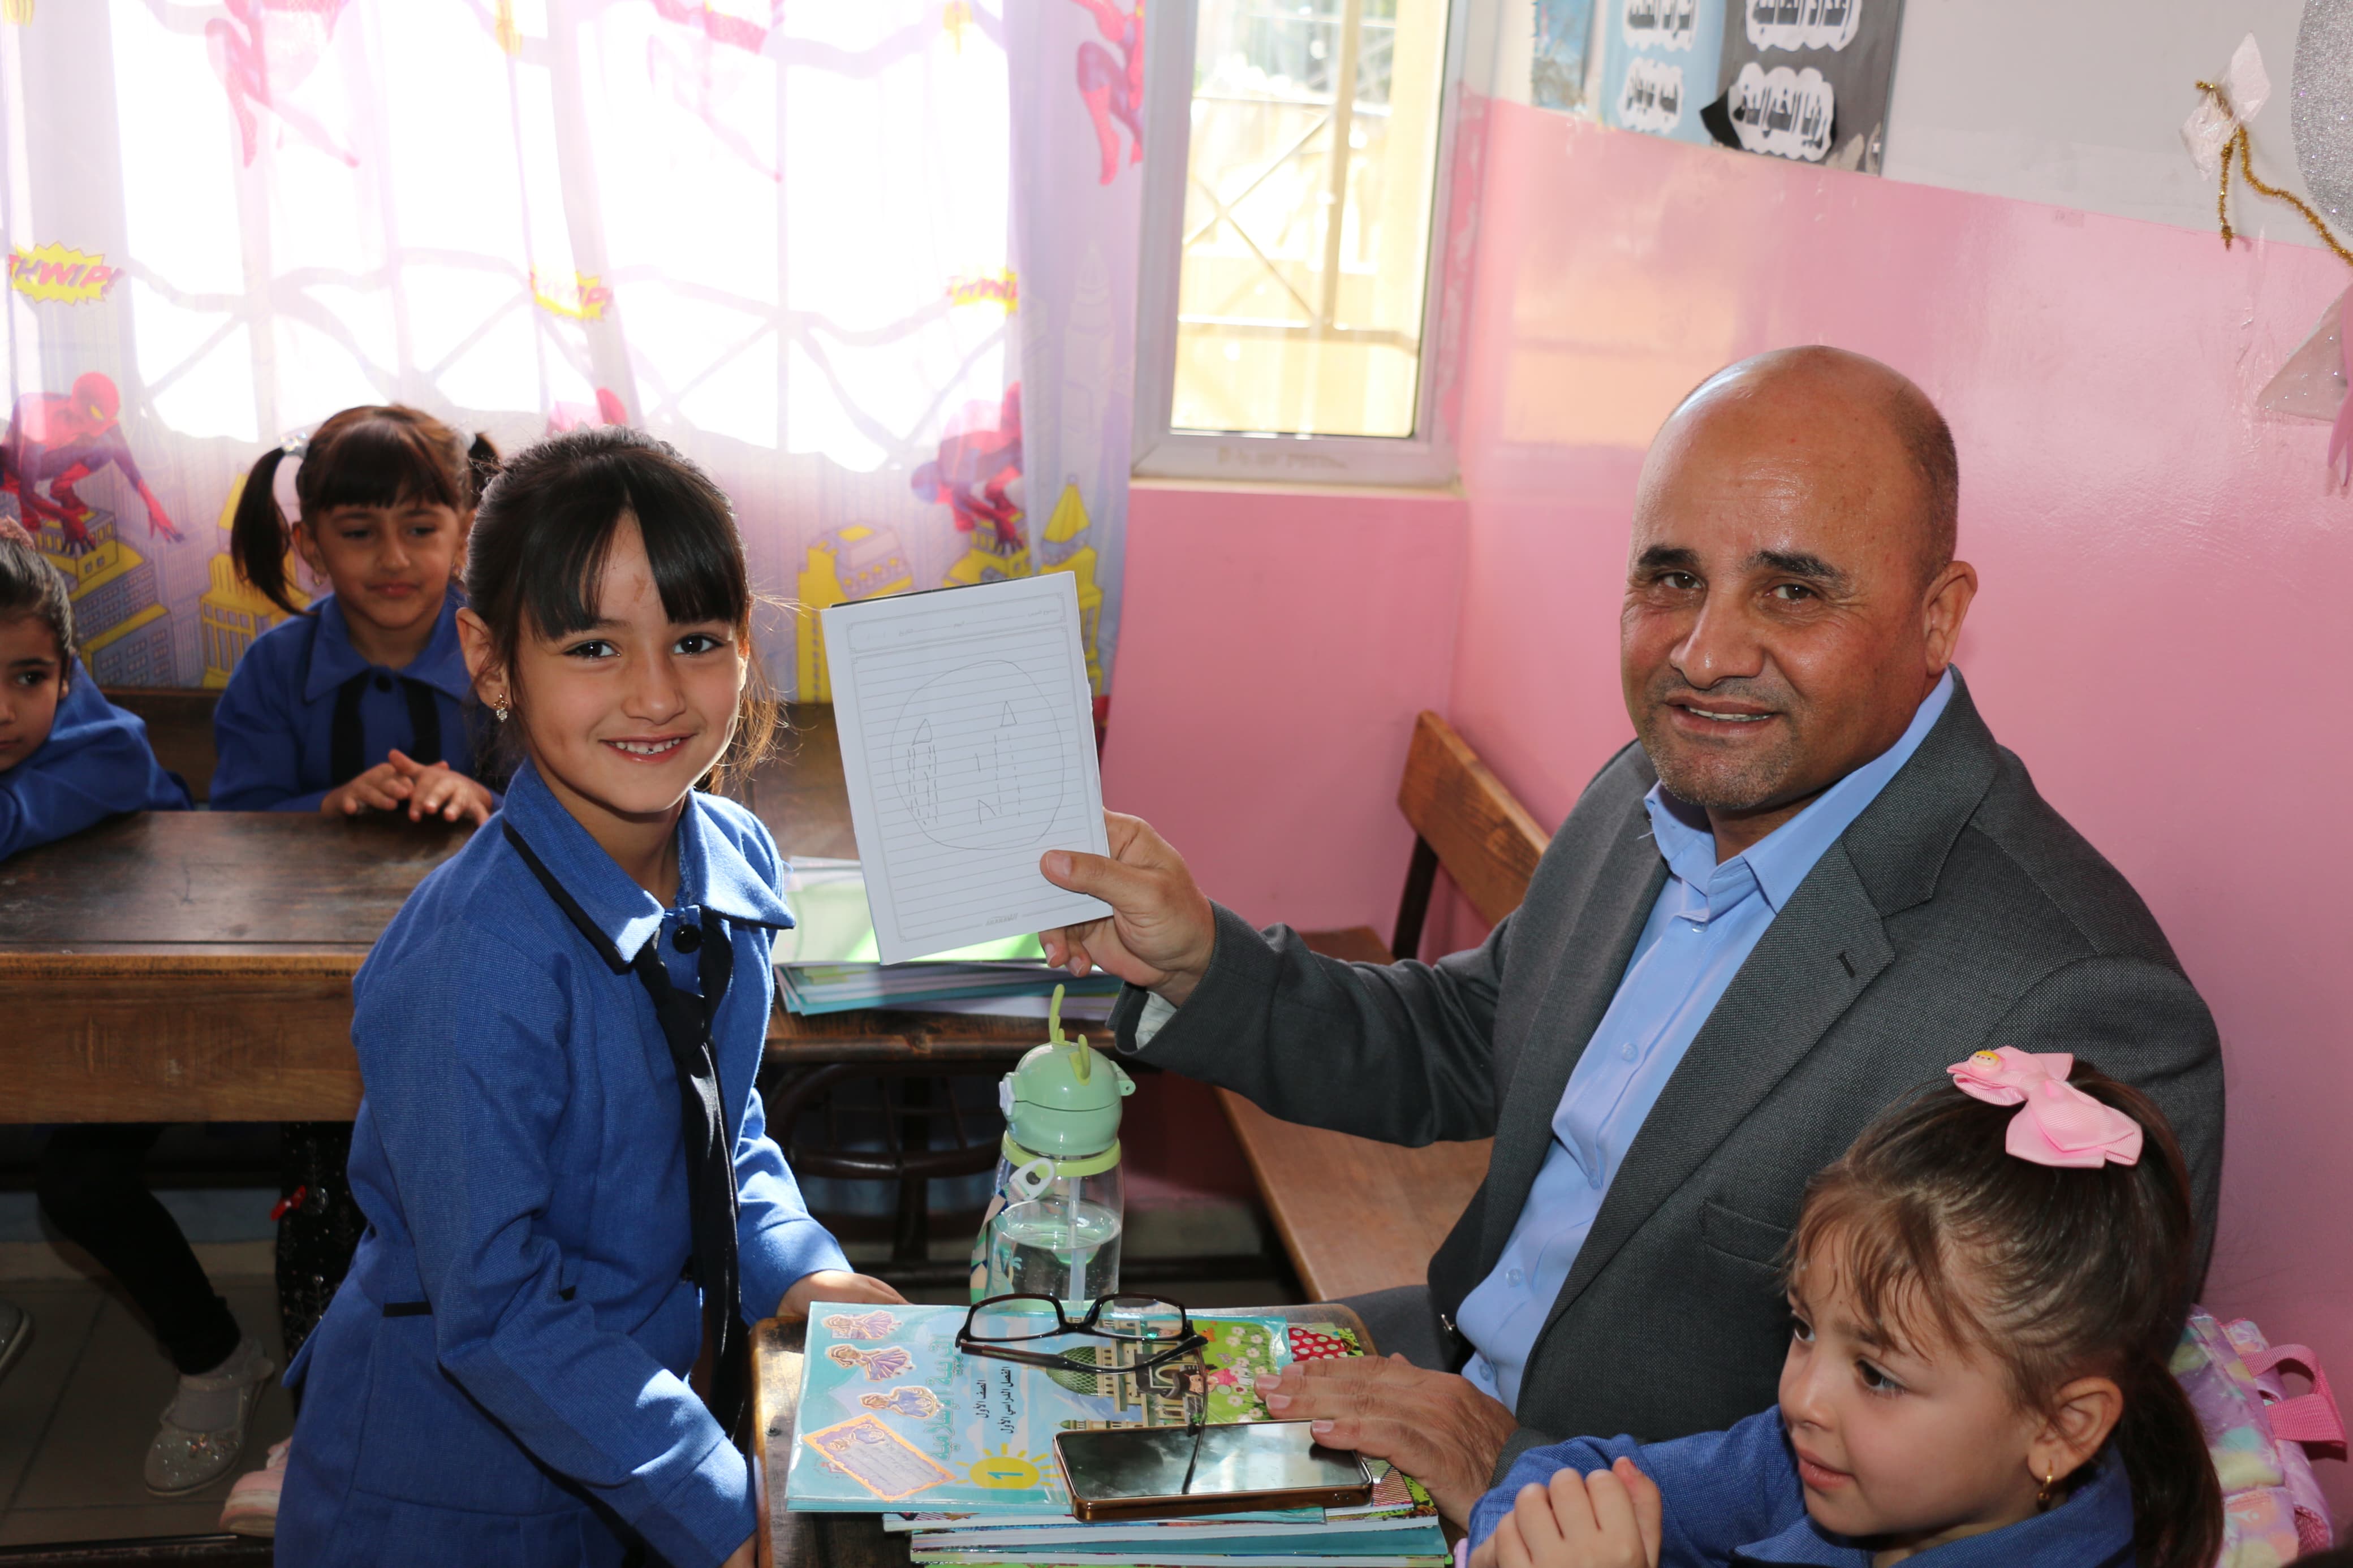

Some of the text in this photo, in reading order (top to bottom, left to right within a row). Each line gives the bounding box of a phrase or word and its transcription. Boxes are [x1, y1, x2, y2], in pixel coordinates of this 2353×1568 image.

[927, 1334, 964, 1386] التربية
[973, 1380, 989, 1419] الصف الأول
[997, 1366, 1016, 1435] الفصل الدراسي الأول
[987, 1471, 1024, 1480] 1
